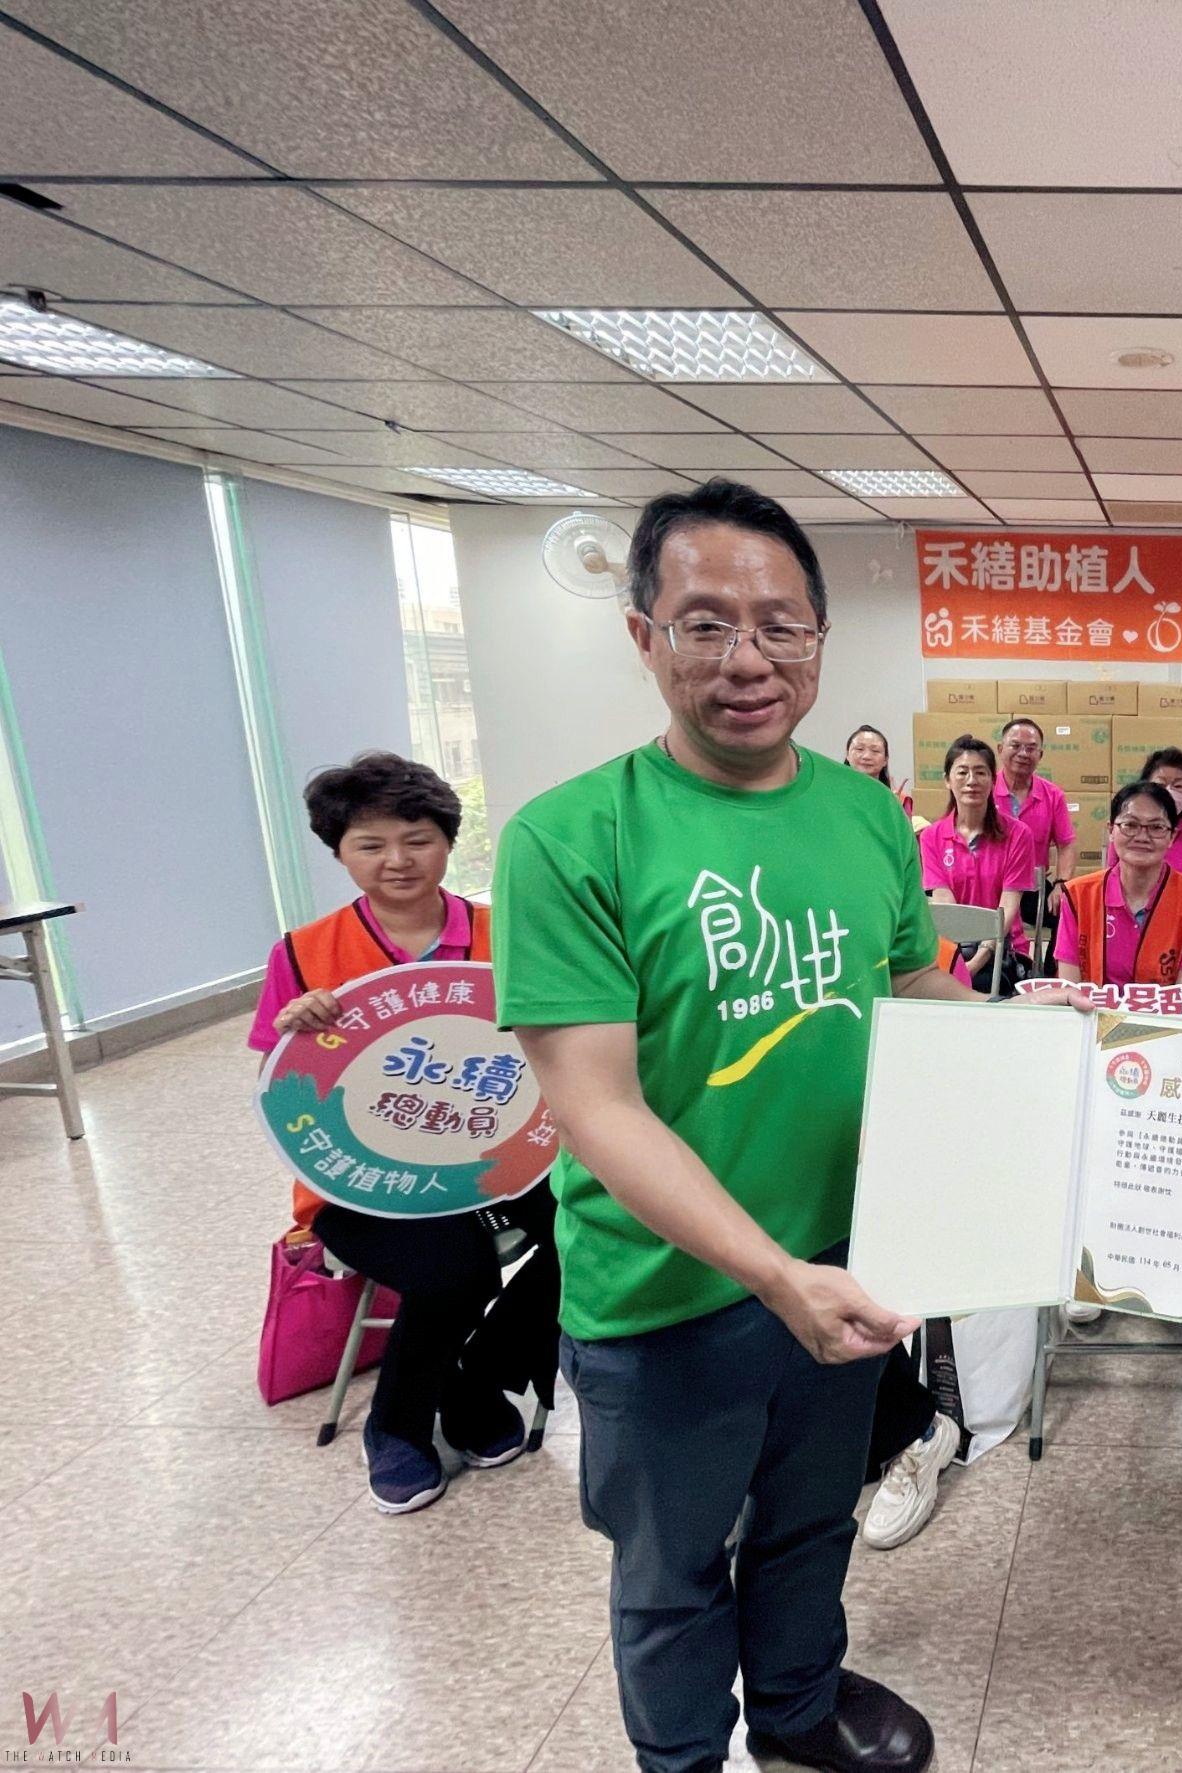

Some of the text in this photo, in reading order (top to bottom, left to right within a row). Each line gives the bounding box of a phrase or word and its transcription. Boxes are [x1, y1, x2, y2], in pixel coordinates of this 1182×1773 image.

[923, 542, 1155, 594] 禾繕助植人
[961, 615, 1115, 648] 禾繕基金會
[717, 991, 775, 1021] 1986
[382, 1036, 526, 1103] 永續
[369, 1092, 499, 1137] 總動員
